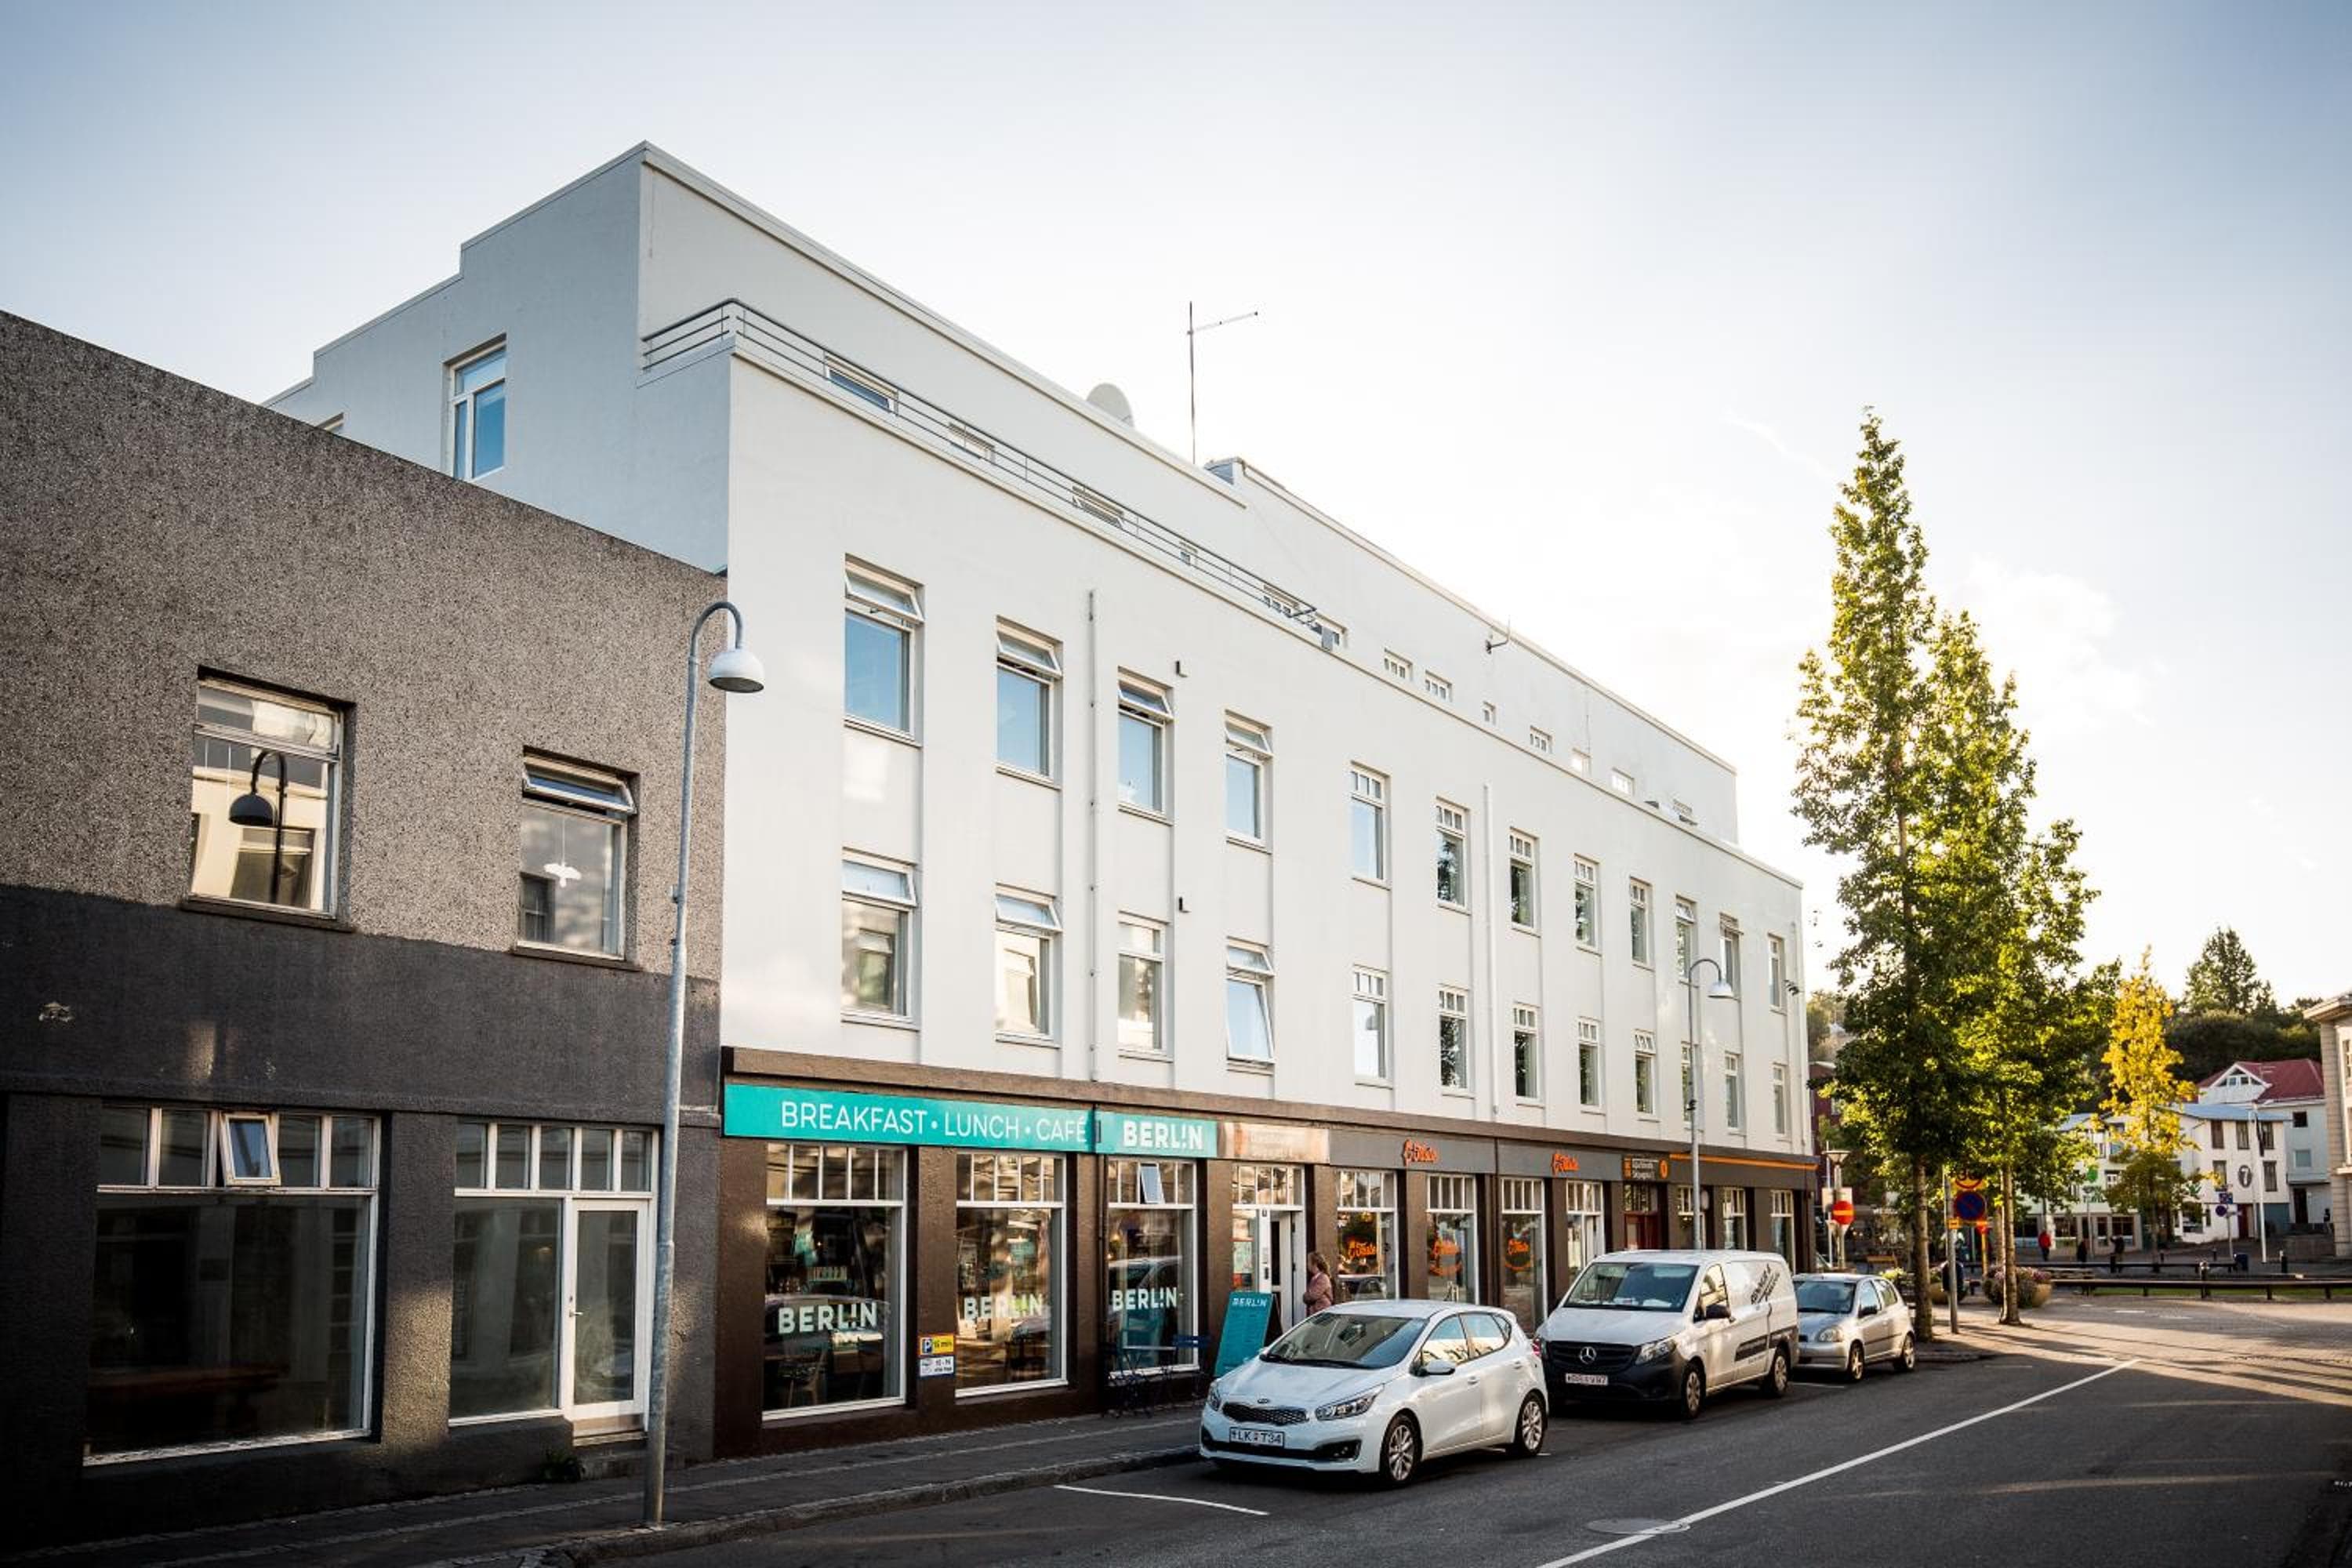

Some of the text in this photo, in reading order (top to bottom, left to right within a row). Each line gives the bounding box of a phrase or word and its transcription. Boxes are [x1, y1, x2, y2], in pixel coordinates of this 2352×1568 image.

[781, 1101, 1087, 1143] BREAKFAST LUNCH CAFÉ
